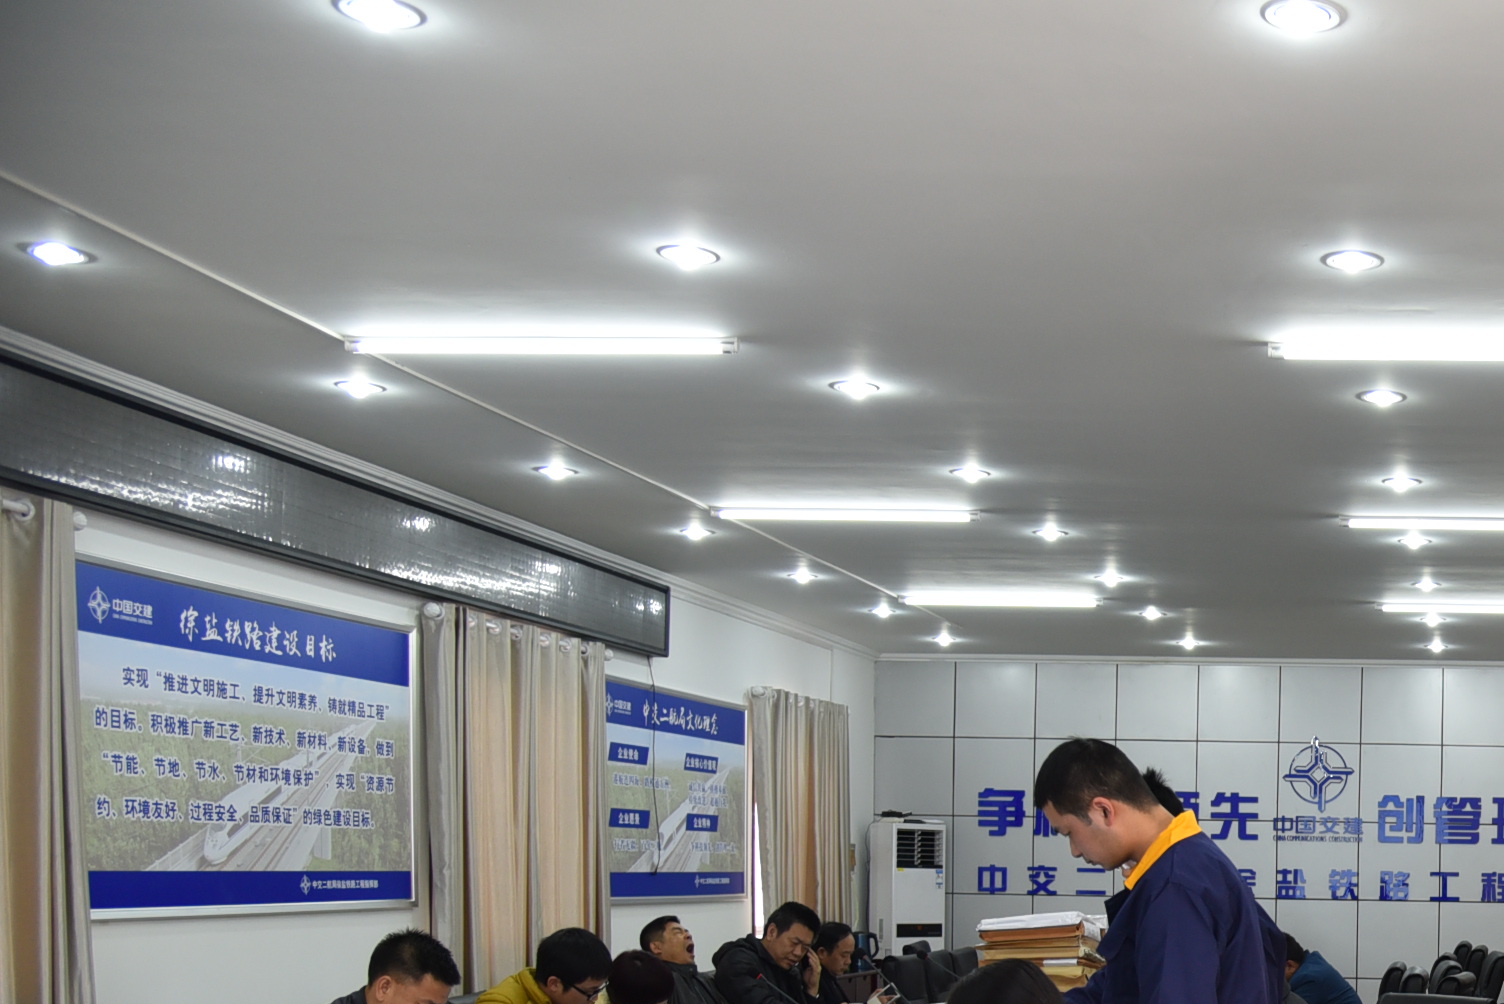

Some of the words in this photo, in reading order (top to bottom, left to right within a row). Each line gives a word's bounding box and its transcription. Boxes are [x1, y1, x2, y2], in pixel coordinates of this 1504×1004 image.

[112, 598, 154, 619] 中国交建
[179, 605, 337, 663] 徐盐铁路建设目标
[1272, 814, 1364, 835] 中国交建
